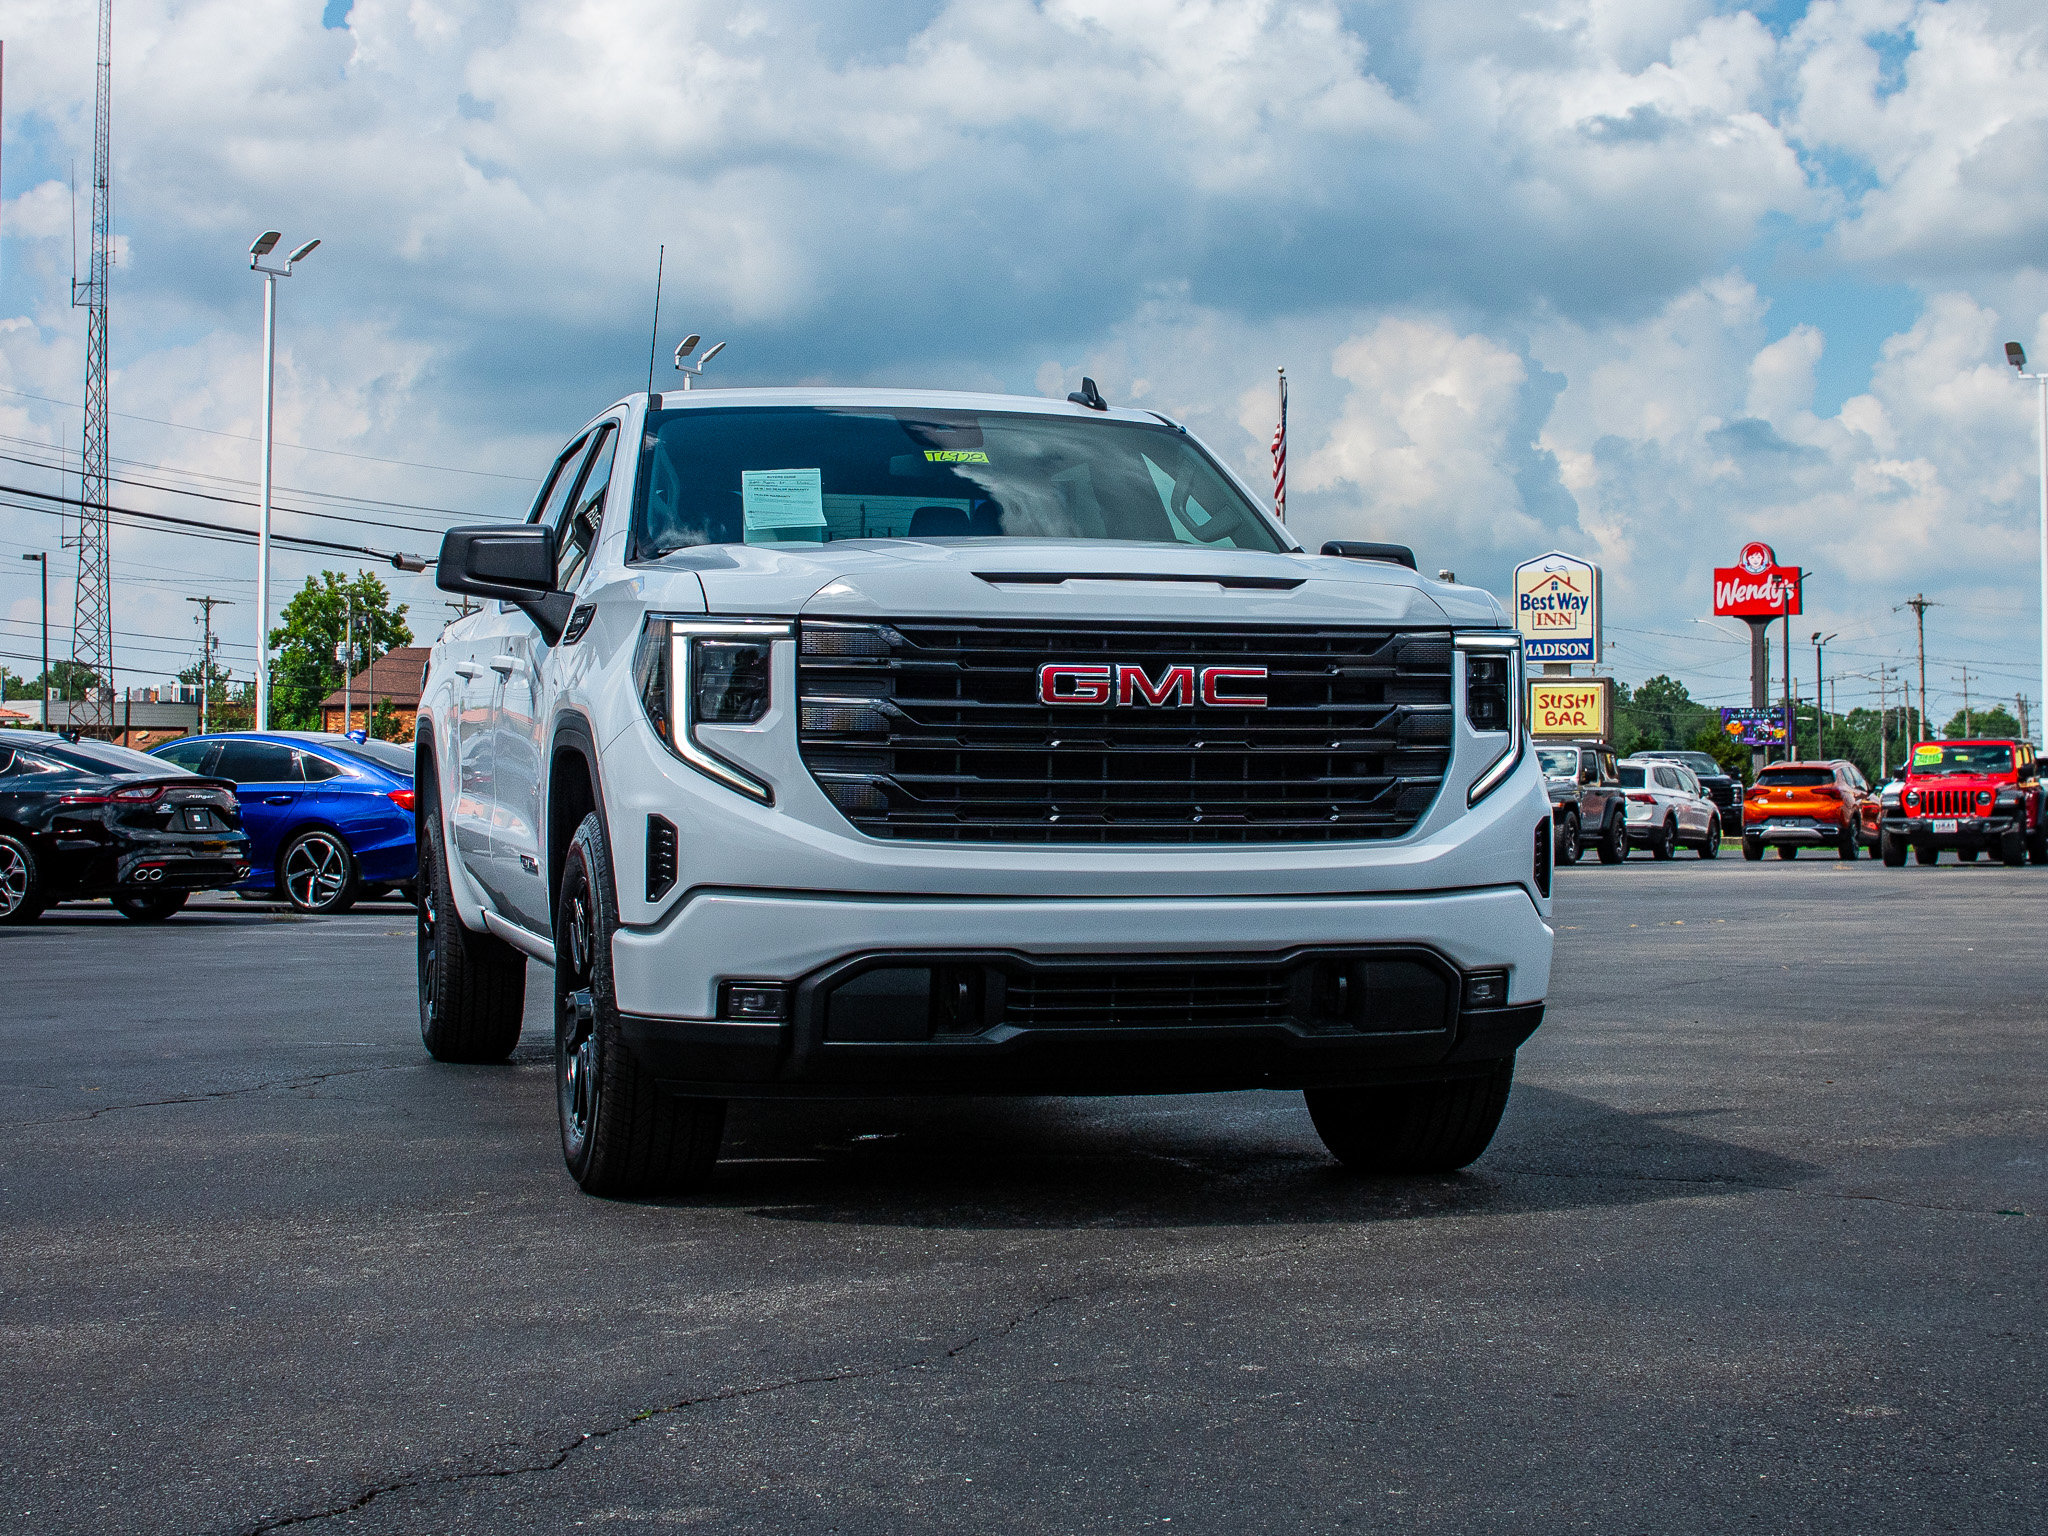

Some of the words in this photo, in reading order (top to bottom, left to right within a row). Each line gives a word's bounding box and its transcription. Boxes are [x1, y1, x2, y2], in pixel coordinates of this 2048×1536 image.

[1716, 573, 1795, 610] Wendy's
[1520, 592, 1555, 611] Best
[1556, 592, 1589, 615] Way
[1536, 612, 1572, 626] INN
[1038, 663, 1268, 708] GMC
[1538, 693, 1595, 709] SUSHI
[1544, 710, 1587, 727] BAR
